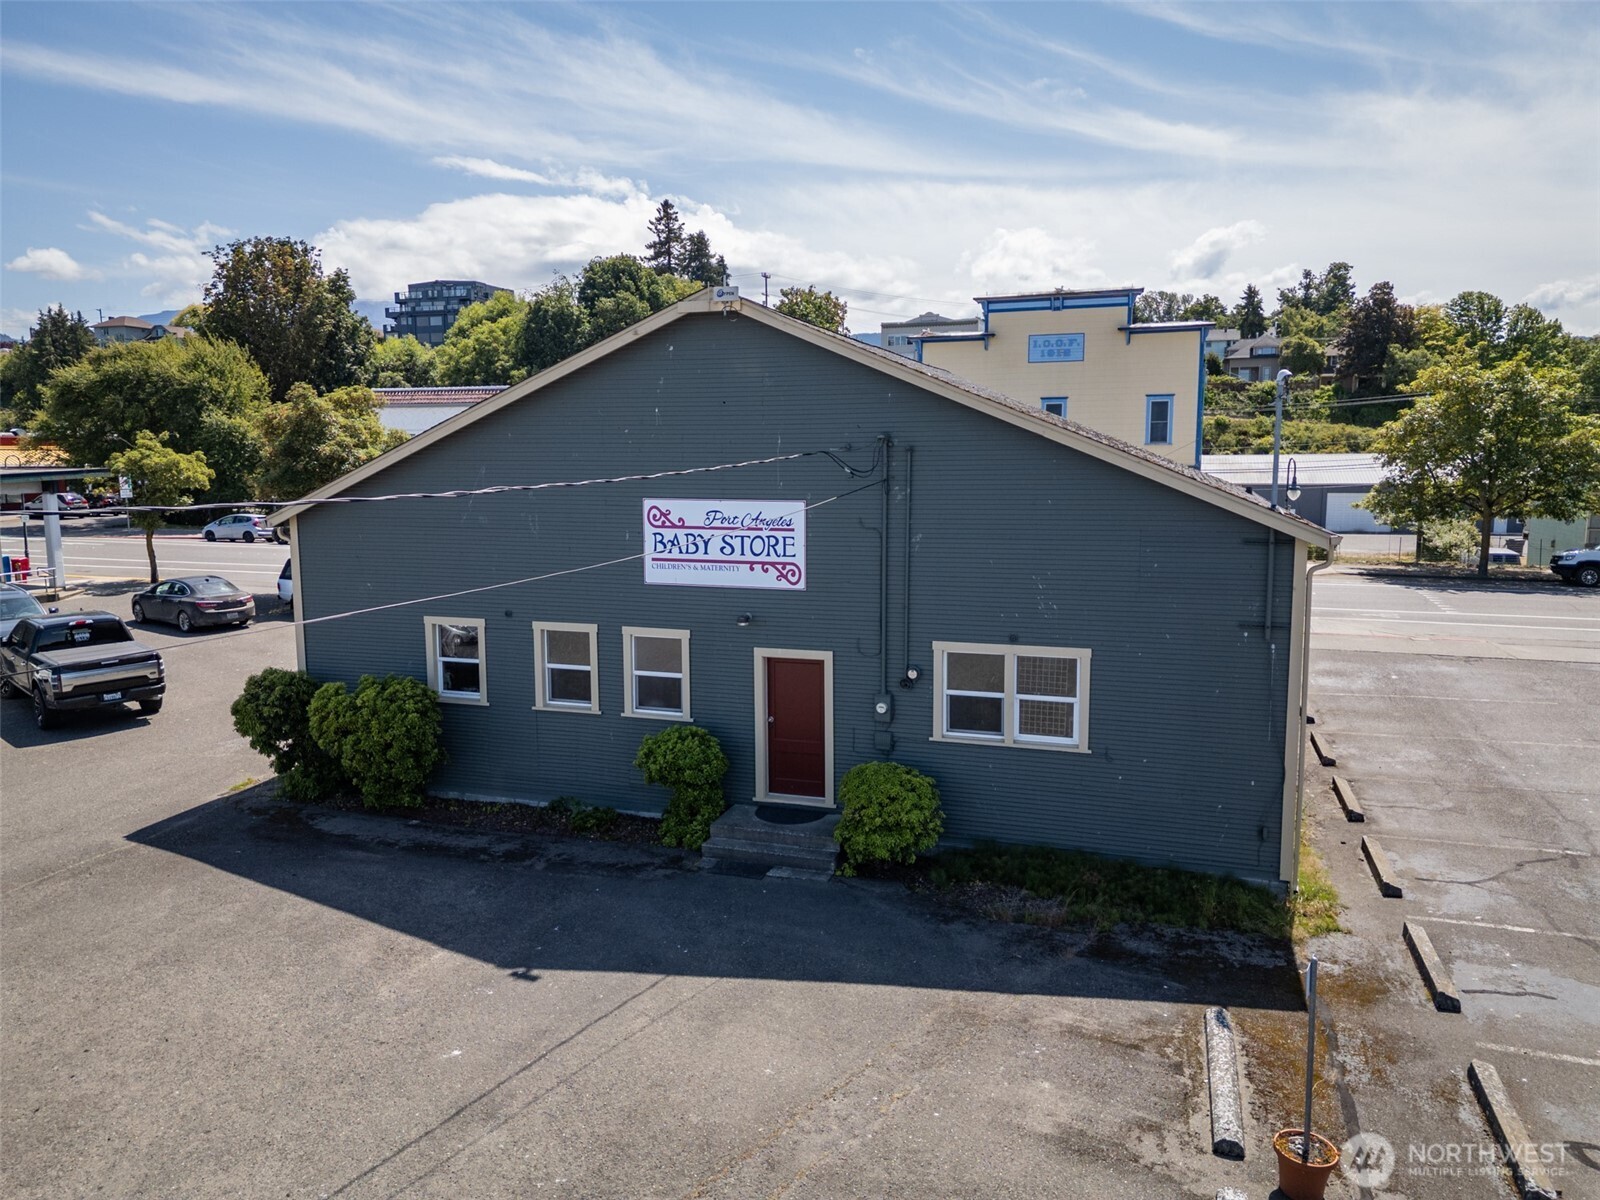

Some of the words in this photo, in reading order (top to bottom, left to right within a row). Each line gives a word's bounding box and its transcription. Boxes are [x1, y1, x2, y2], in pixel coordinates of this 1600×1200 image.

[704, 509, 740, 527] Port
[741, 511, 794, 530] Angeles
[652, 532, 715, 555] BABY
[719, 535, 796, 558] STORE
[651, 563, 692, 571] CHILDREN'S
[699, 564, 741, 572] MATERNITY
